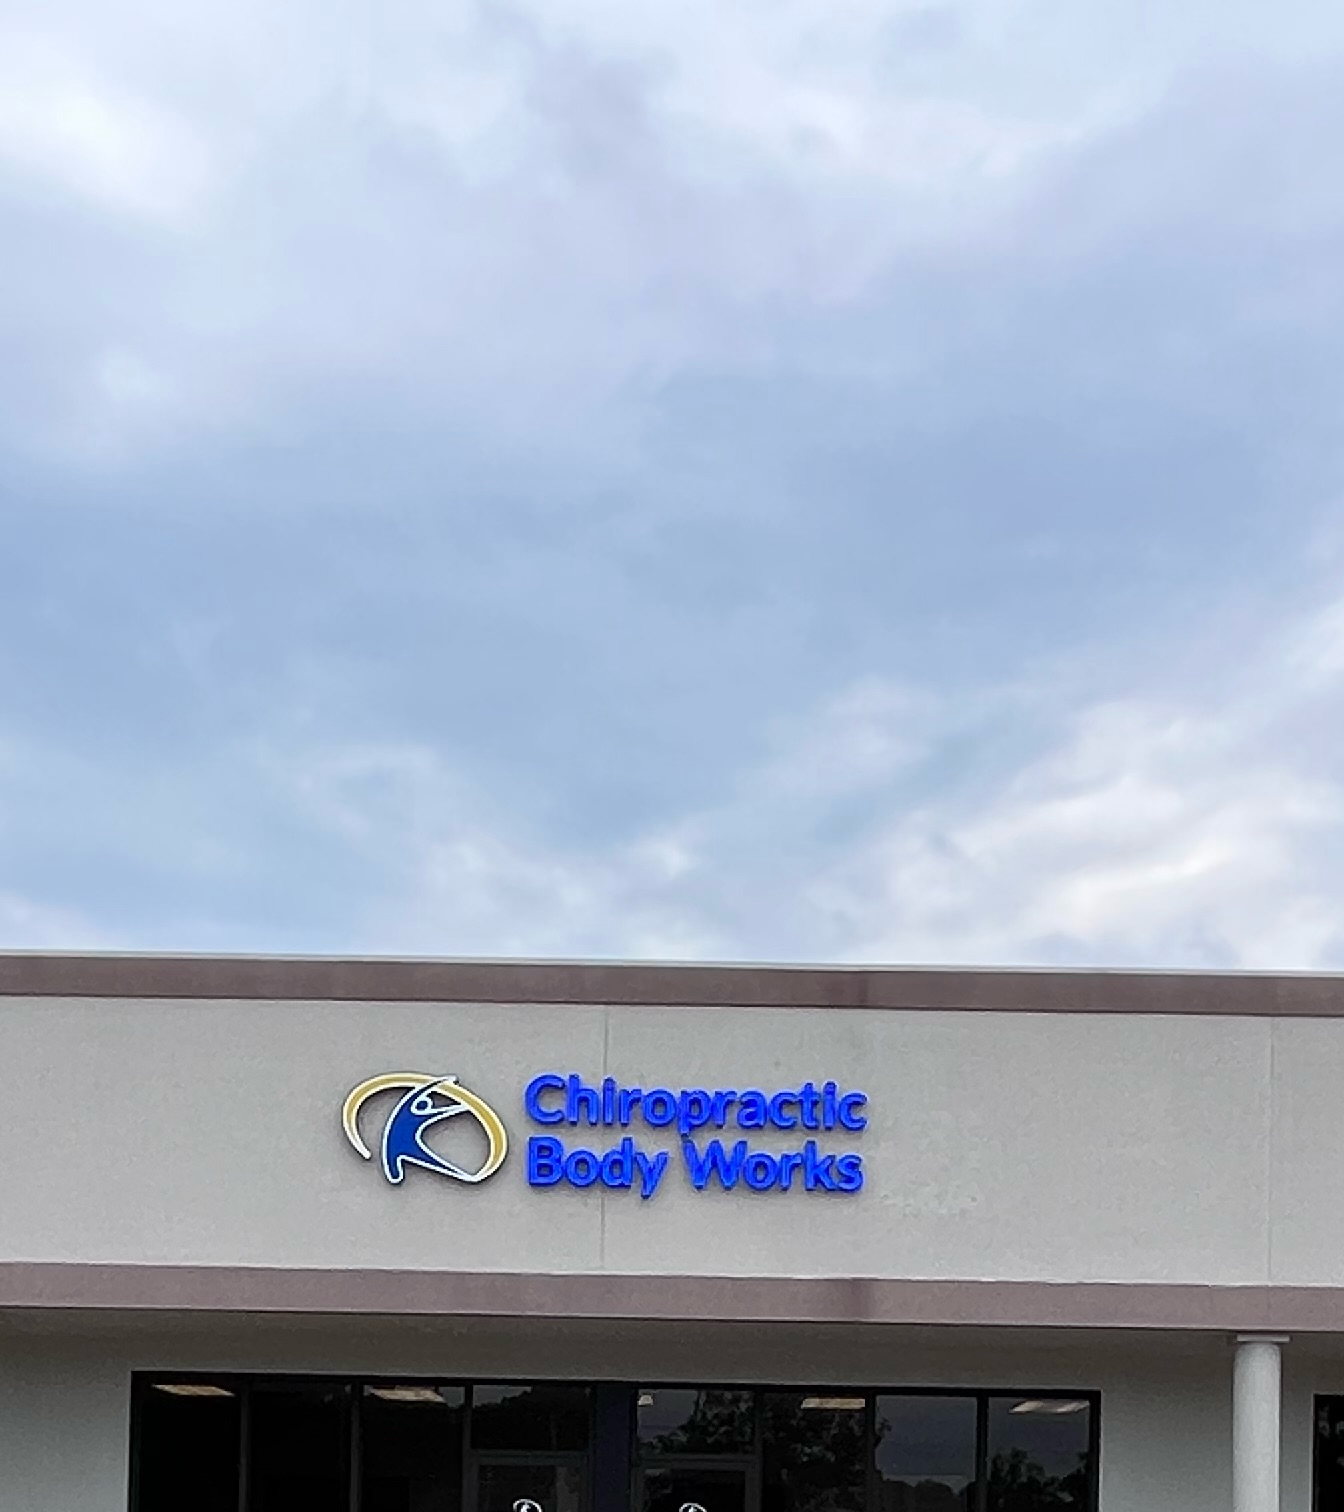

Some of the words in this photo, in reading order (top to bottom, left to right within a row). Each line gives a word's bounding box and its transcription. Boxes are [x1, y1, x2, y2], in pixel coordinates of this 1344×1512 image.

[524, 1073, 868, 1135] Chiropractic
[528, 1136, 668, 1199] Body
[682, 1137, 864, 1192] Works
